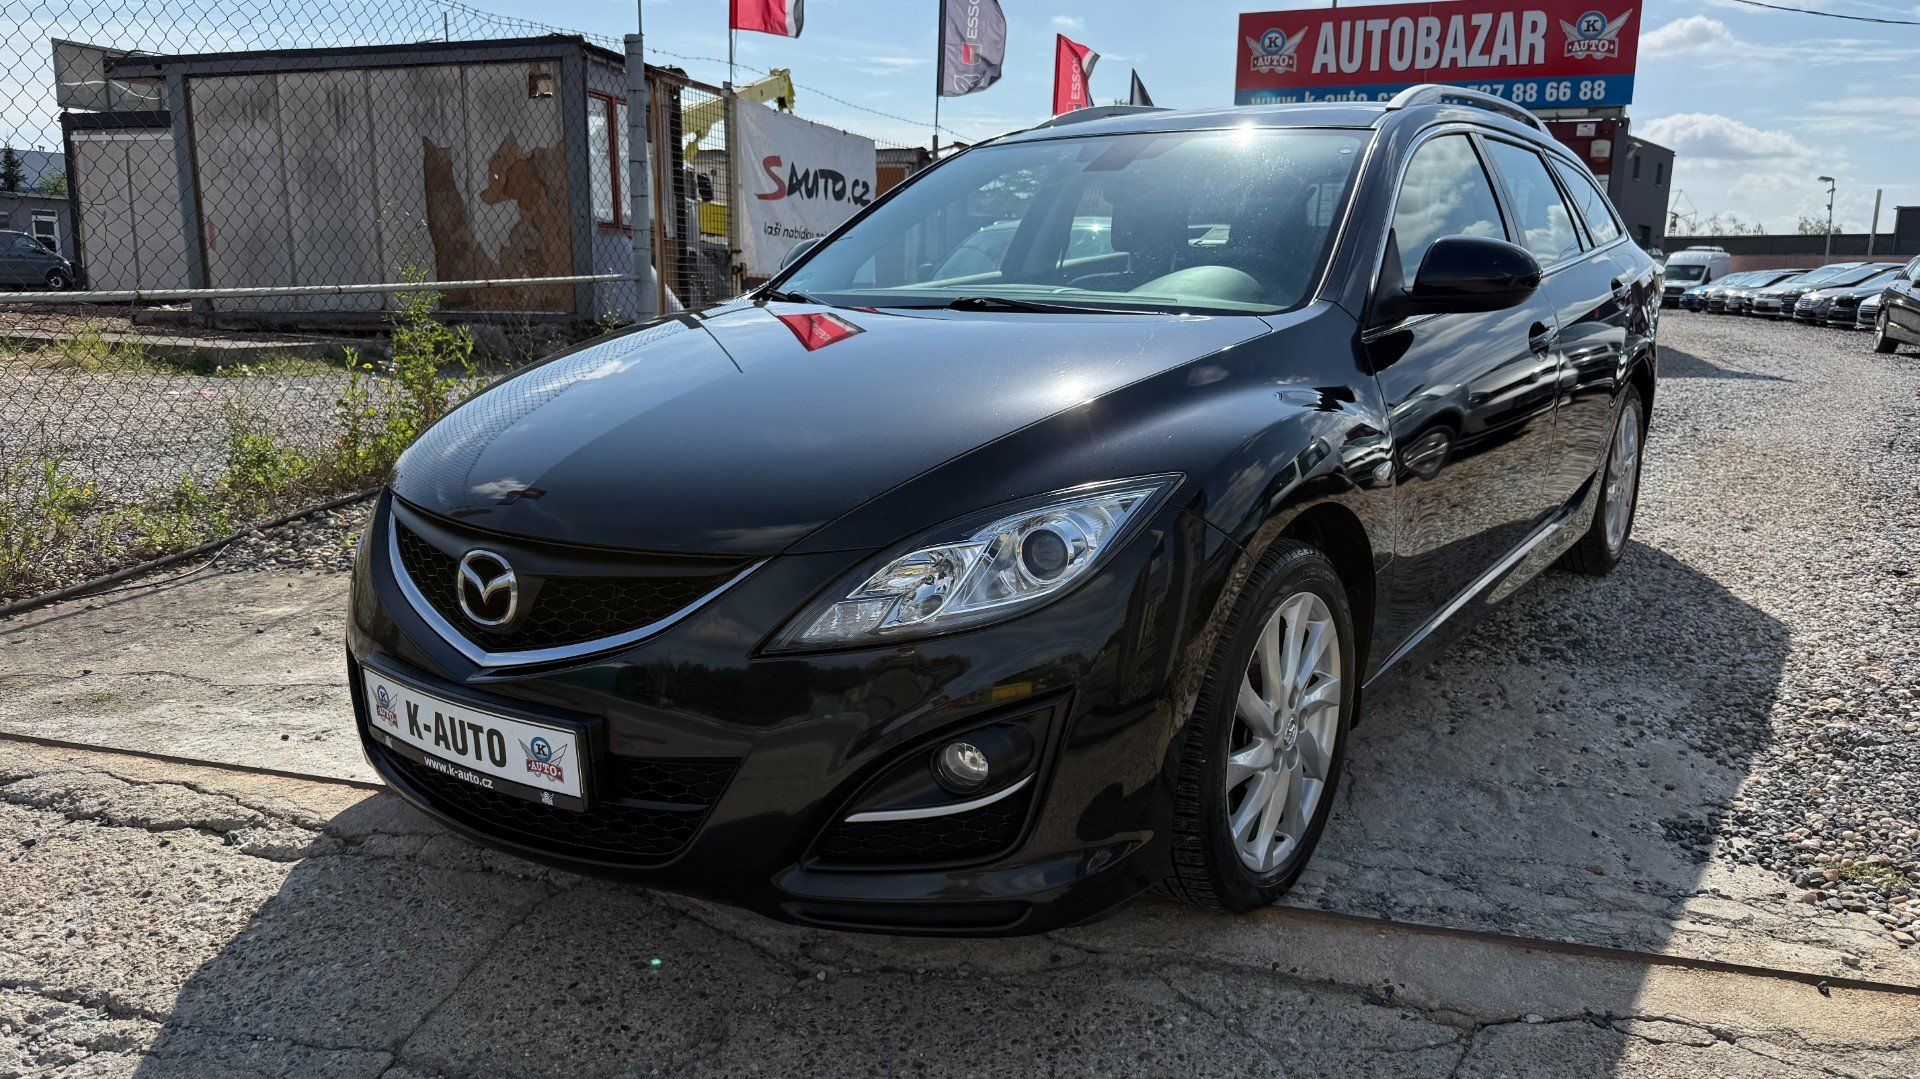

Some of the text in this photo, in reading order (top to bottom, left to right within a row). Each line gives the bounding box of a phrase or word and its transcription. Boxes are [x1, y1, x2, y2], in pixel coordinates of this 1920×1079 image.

[1583, 19, 1600, 33] K
[1266, 36, 1280, 49] K
[1311, 10, 1547, 74] AUTOBAZAR
[1571, 40, 1609, 52] AUTO
[1256, 55, 1289, 67] AUTO
[1511, 82, 1538, 103] 88
[1544, 81, 1571, 102] 66
[1579, 80, 1606, 100] 88
[405, 700, 507, 768] K-AUTO
[535, 742, 548, 757] K
[424, 756, 494, 789] www.k-auto.cz
[530, 760, 558, 777] AUTO
